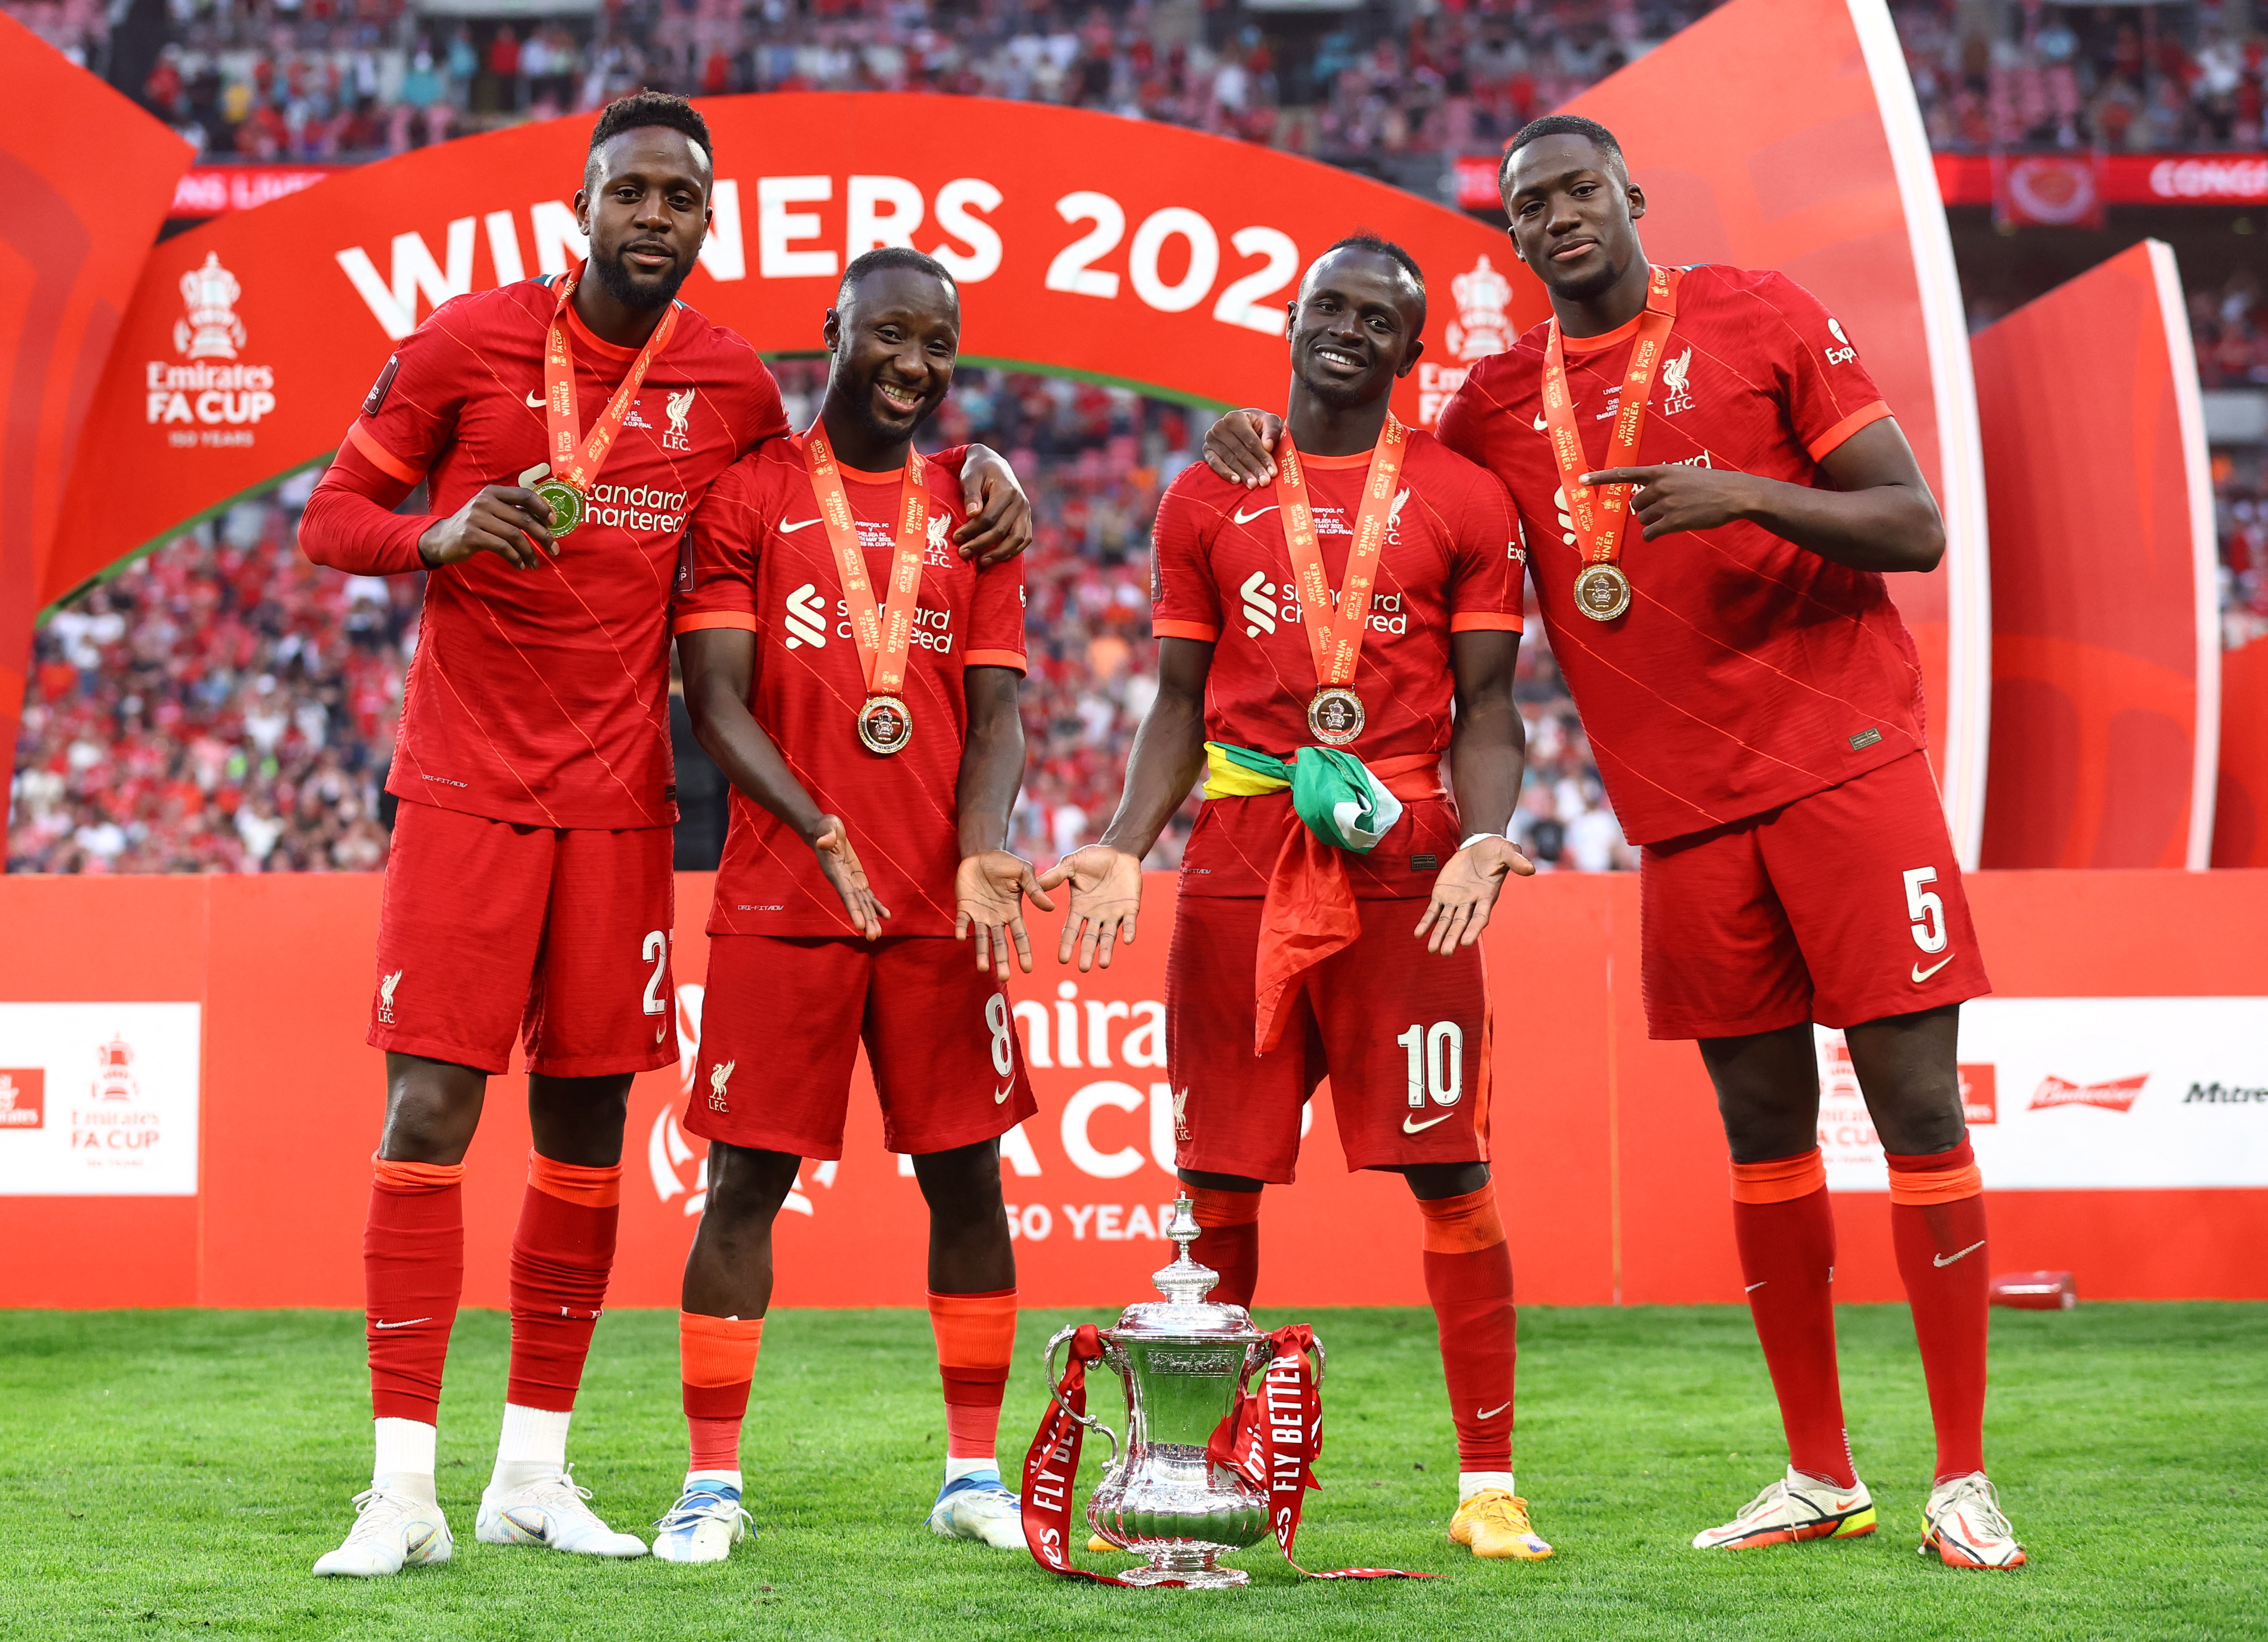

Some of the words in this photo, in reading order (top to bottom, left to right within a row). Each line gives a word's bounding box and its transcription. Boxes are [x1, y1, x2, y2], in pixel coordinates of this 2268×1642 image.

[1045, 191, 1300, 336] 202
[1635, 340, 1649, 367] Emirates
[1642, 357, 1650, 368] FA
[1645, 341, 1655, 357] CUP
[146, 360, 273, 390] Emirates
[1547, 382, 1555, 392] FA
[552, 385, 561, 412] 2021-22
[559, 381, 571, 417] WINNER
[610, 388, 629, 419] WINNER
[1549, 392, 1558, 408] CUP
[1554, 379, 1563, 406] Emirates
[1664, 396, 1696, 416] L.F.C.
[146, 391, 194, 424] FA
[195, 390, 275, 425] CUP
[1386, 412, 1396, 445] WINNER
[1618, 407, 1630, 439] 2021-22
[1624, 401, 1640, 447] WINNER
[563, 431, 571, 443] CUP
[564, 443, 572, 452] FA
[594, 437, 601, 447] FA
[663, 434, 691, 451] L.F.C.
[815, 439, 825, 453] CUP
[1555, 426, 1573, 471] WINNER
[1564, 430, 1578, 462] 2021-22
[588, 445, 597, 458] CUP
[810, 442, 821, 465] Emirates
[820, 453, 828, 462] FA
[1281, 458, 1291, 484] 2021-22
[1286, 448, 1300, 488] WINNER
[1376, 473, 1385, 482] FA
[1373, 483, 1382, 499] CUP
[1380, 474, 1391, 499] Emirates
[581, 502, 686, 533] hartered
[825, 498, 839, 526] 2021-22
[831, 490, 850, 531] WINNER
[905, 497, 917, 535] WINNER
[914, 504, 924, 531] 2021-22
[1291, 505, 1300, 531] Emirates
[1296, 504, 1305, 519] CUP
[1577, 504, 1585, 515] FA
[1300, 518, 1308, 530] FA
[1357, 514, 1375, 557] WINNER
[1368, 521, 1381, 551] 2021-22
[1580, 515, 1591, 532] CUP
[843, 549, 854, 576] Emirates
[848, 548, 857, 564] CUP
[901, 565, 908, 574] FA
[853, 566, 861, 575] FA
[906, 567, 916, 593] Emirates
[899, 577, 907, 592] CUP
[1303, 570, 1316, 602] 2021-22
[1310, 562, 1326, 608] WINNER
[1349, 591, 1358, 601] FA
[1346, 603, 1355, 620] CUP
[1353, 592, 1365, 621] Emirates
[859, 616, 872, 647] 2021-22
[887, 610, 902, 654] WINNER
[897, 618, 908, 649] 2021-22
[1318, 627, 1328, 655] Emirates
[1329, 639, 1347, 684] WINNER
[1340, 646, 1354, 679] 2021-22
[1902, 866, 1947, 954] 5
[378, 1011, 395, 1024] L.F.C.
[985, 992, 1014, 1077] 8
[1397, 1020, 1463, 1108] 10
[708, 1098, 729, 1113] L.F.C.
[72, 1130, 99, 1149] FA
[107, 1130, 159, 1149] CUP
[1266, 1354, 1303, 1444] BETTER
[1273, 1452, 1300, 1491] FLY
[1033, 1469, 1065, 1512] FLY
